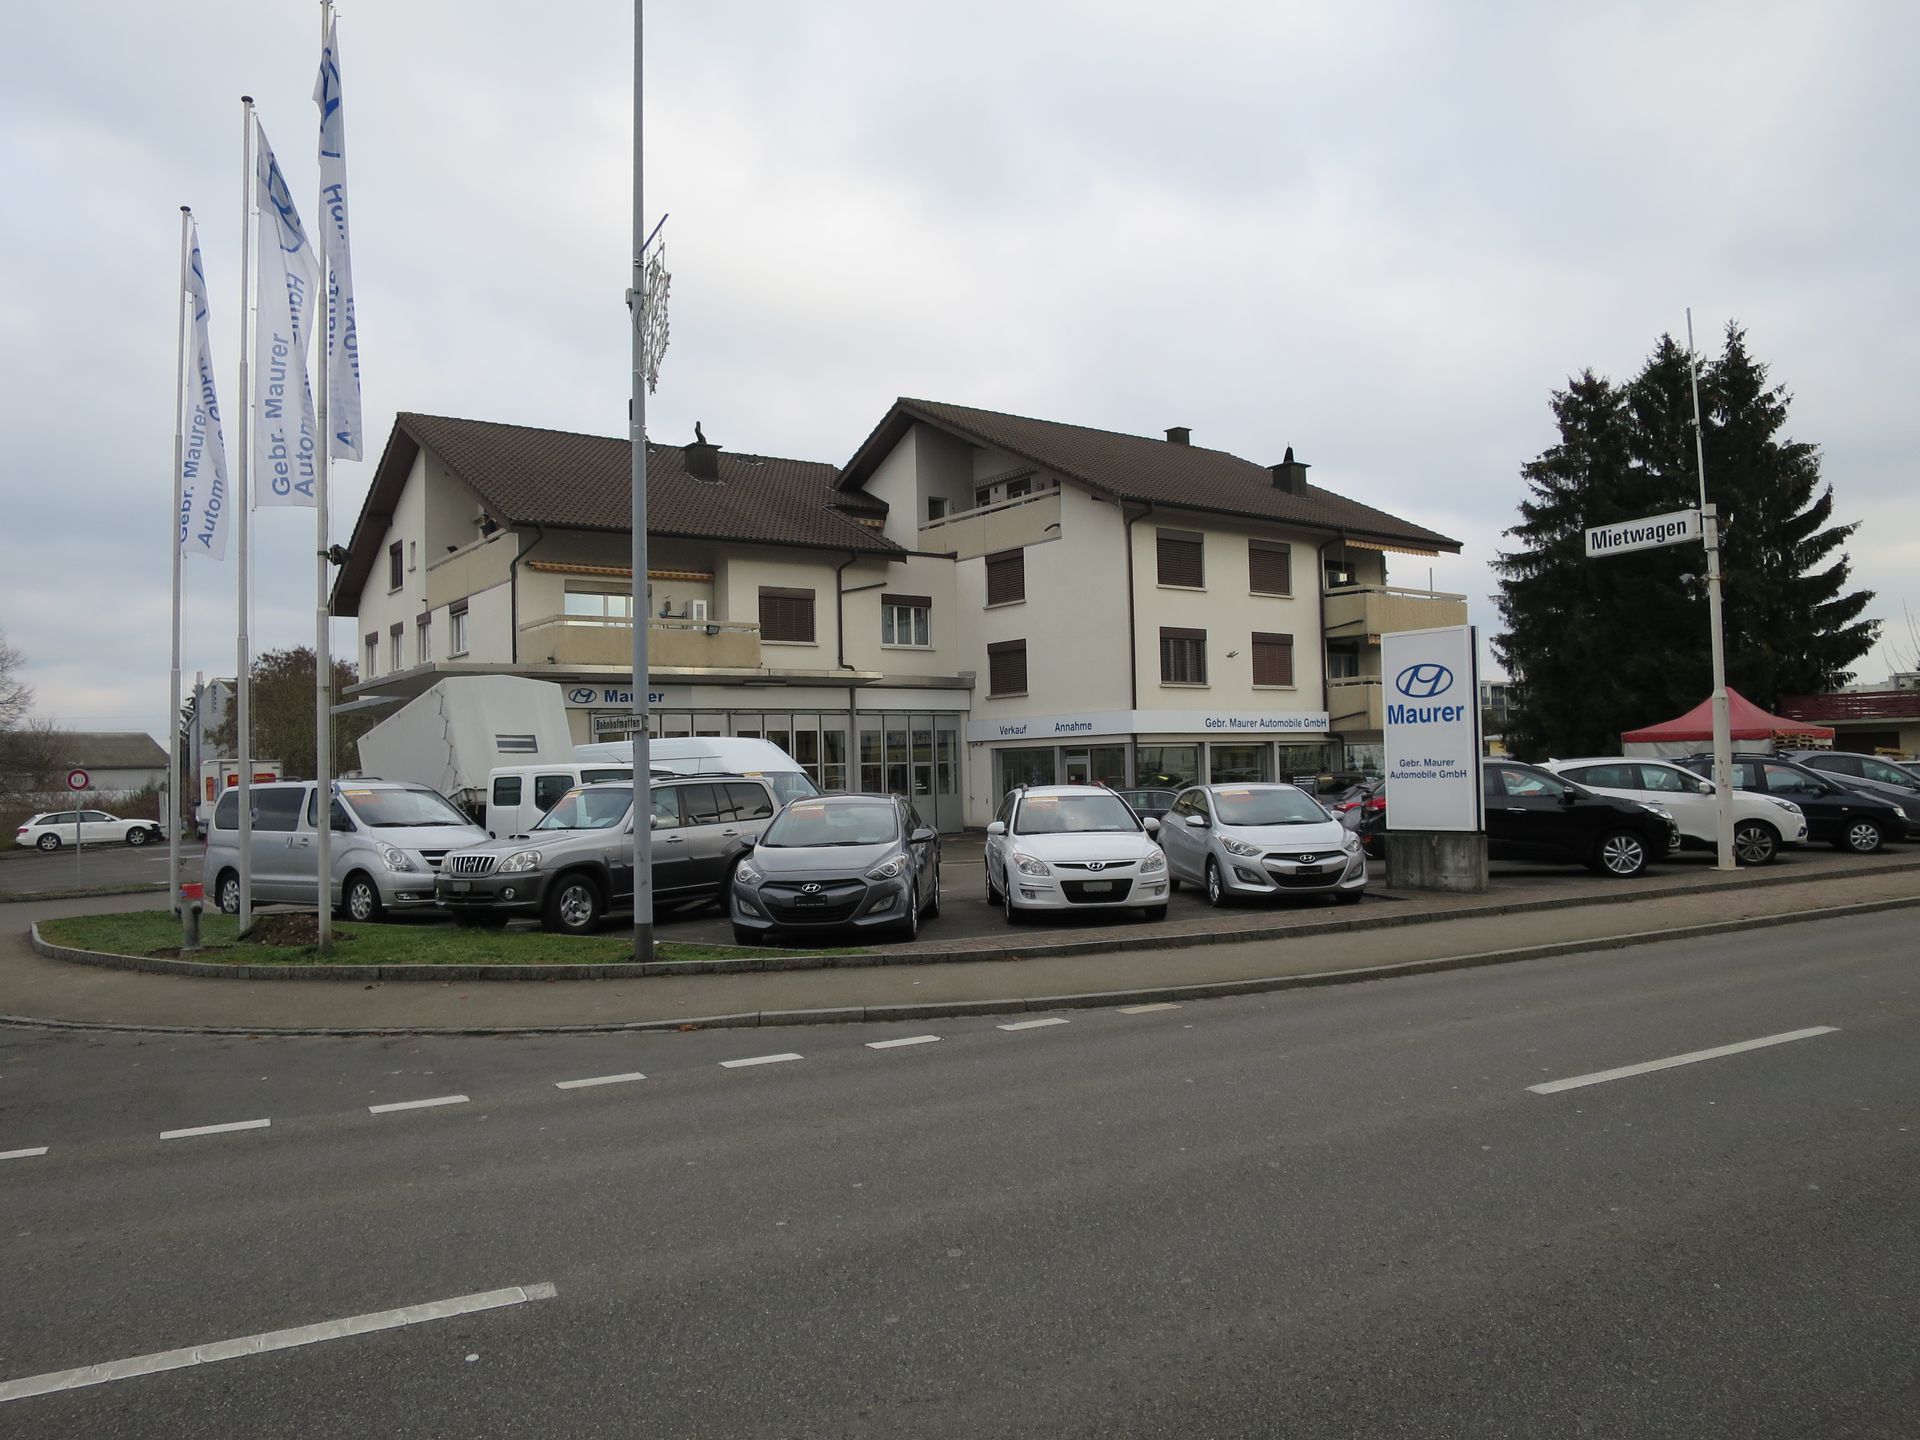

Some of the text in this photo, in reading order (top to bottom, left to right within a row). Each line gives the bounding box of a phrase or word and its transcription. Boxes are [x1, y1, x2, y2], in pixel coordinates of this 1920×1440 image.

[265, 333, 291, 497] Gebr. Maurer
[183, 404, 208, 479] Maurer
[1591, 520, 1687, 550] Mietwagen
[604, 689, 665, 703] Maer
[1387, 703, 1465, 725] Maurer
[1054, 721, 1093, 732] Annahme
[1205, 718, 1327, 728] Gebr. Maurer Automobile GmbH
[999, 724, 1027, 735] Verkauf
[1399, 758, 1456, 768] Gebr. Maurer
[1389, 769, 1468, 780] Automobile GmbH
